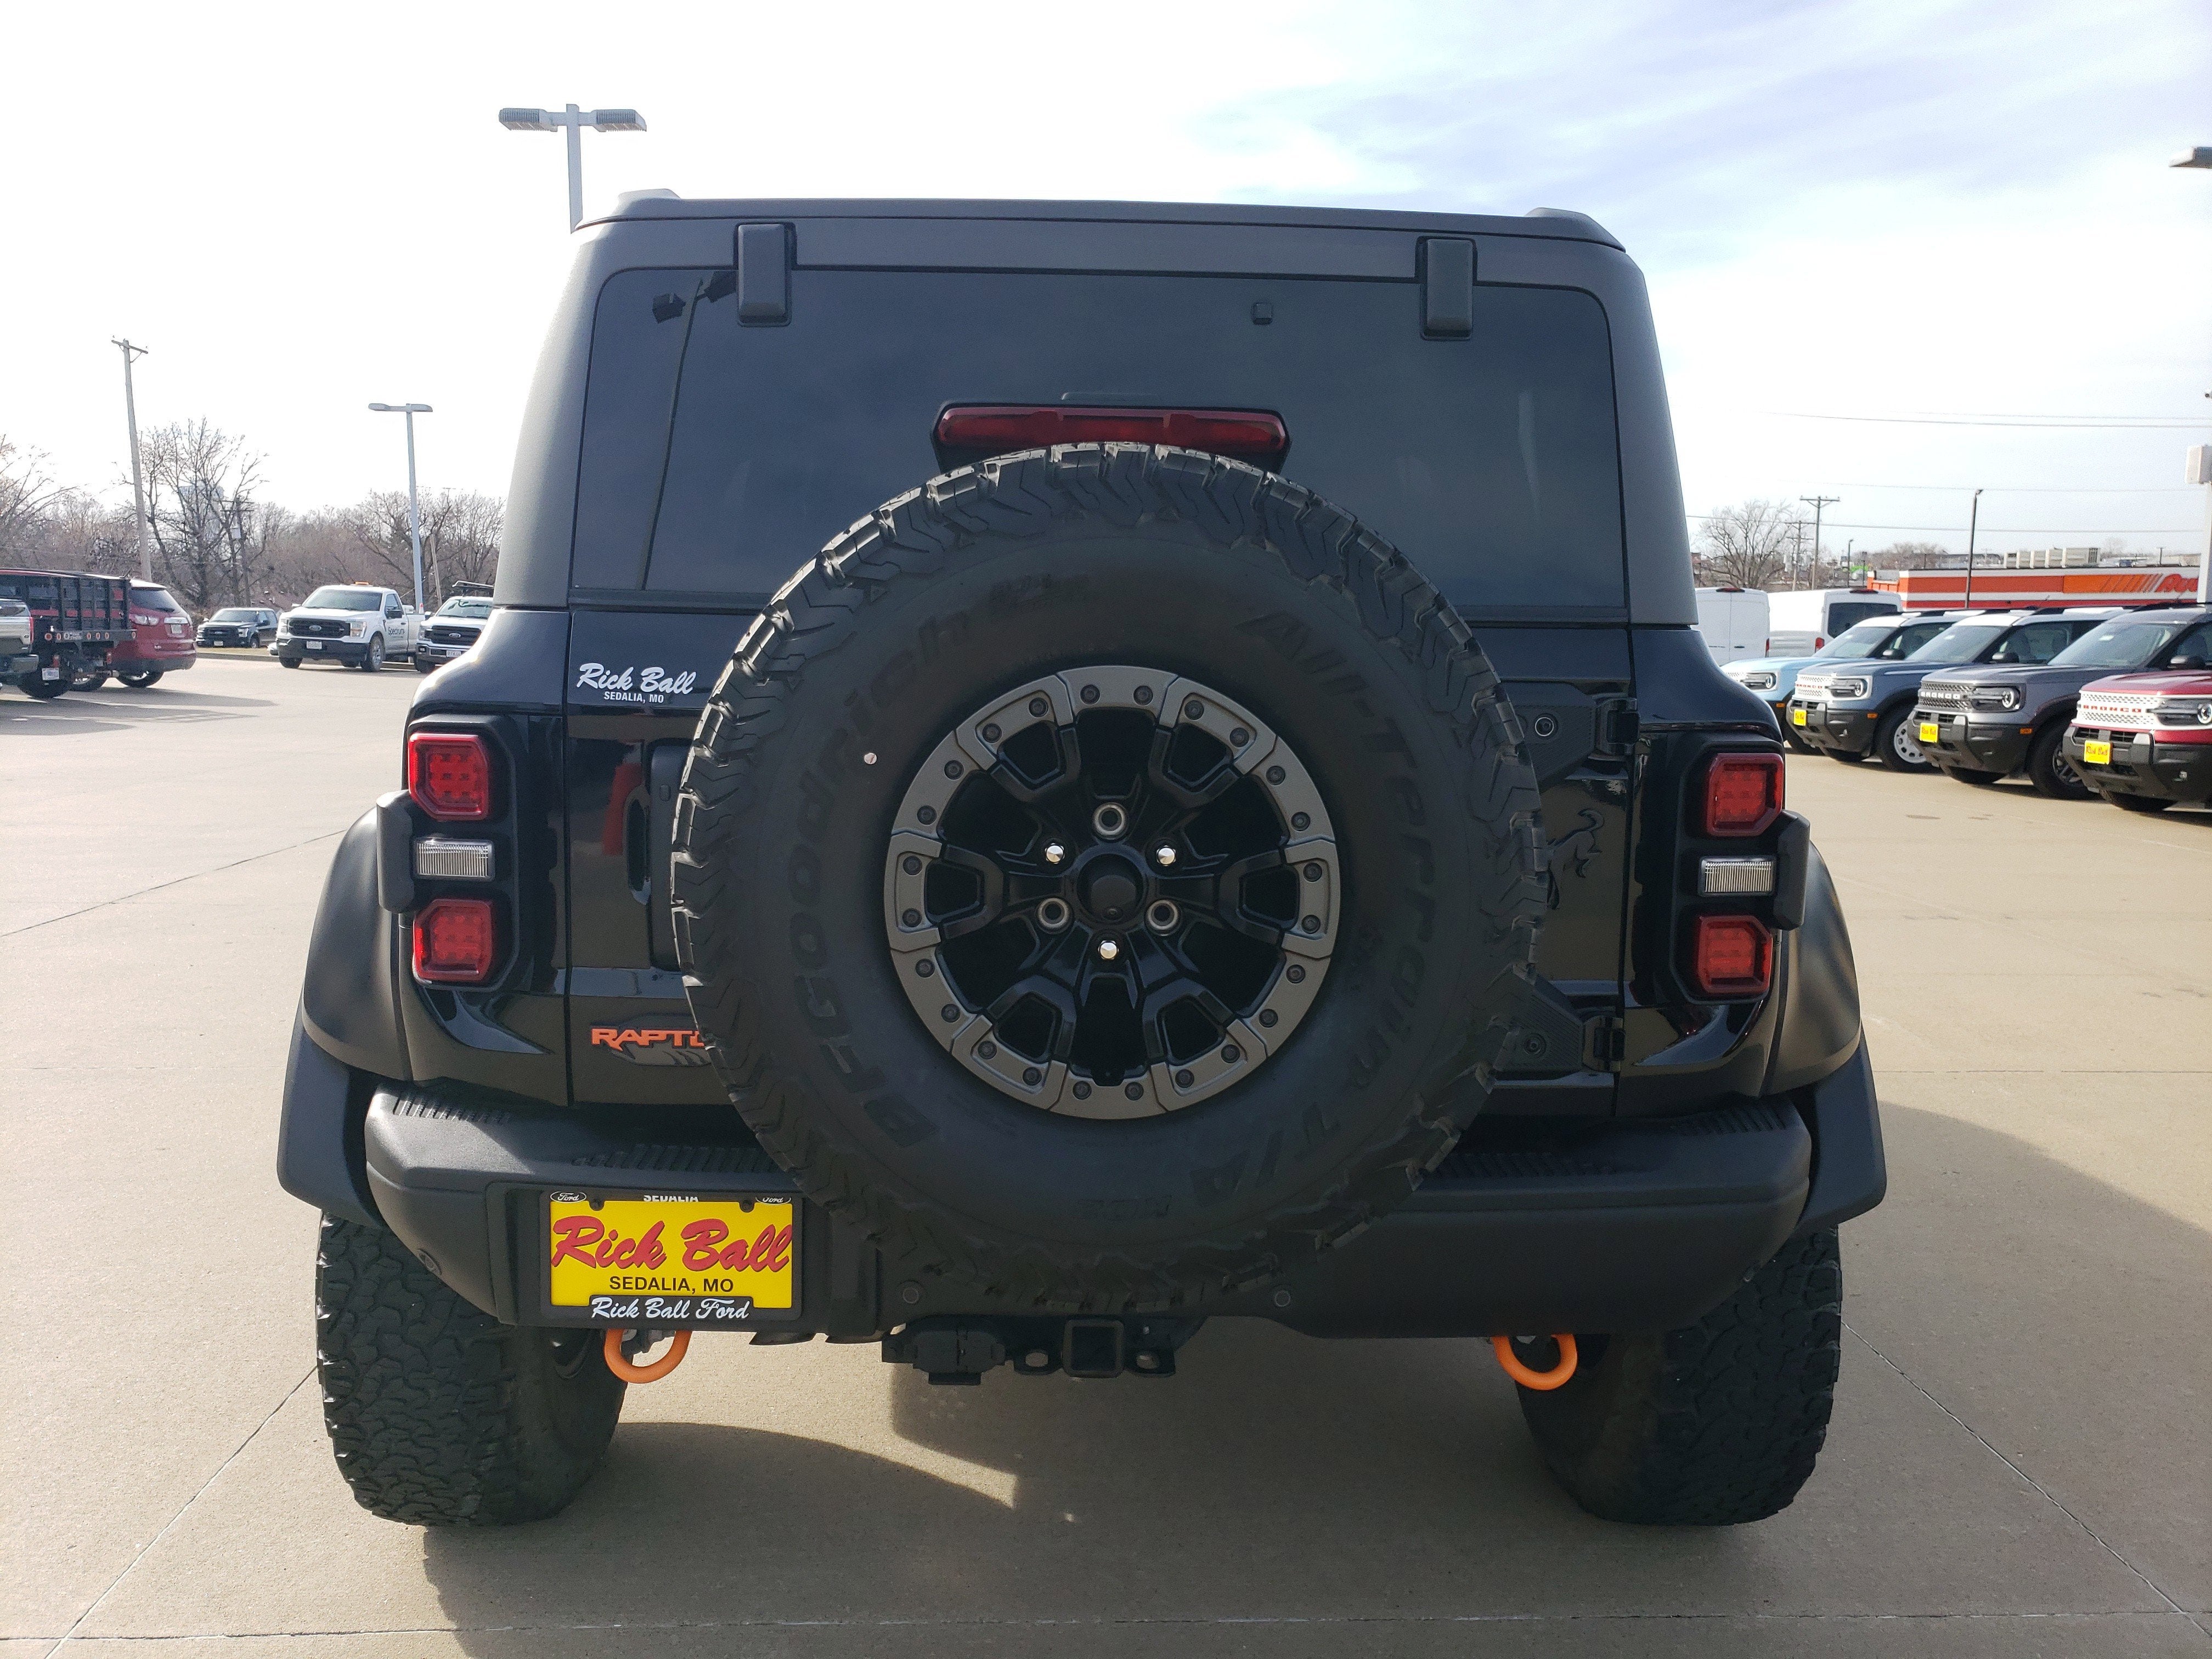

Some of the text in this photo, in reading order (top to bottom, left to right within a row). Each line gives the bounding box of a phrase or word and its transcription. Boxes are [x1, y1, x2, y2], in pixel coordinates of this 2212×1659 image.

[577, 663, 697, 695] Rick Ball
[603, 691, 664, 704] SEDALIA, MO
[1921, 691, 1961, 699] BRONCO
[2083, 704, 2142, 713] BRONCO
[788, 609, 971, 1149] BFGoodrich
[557, 1192, 580, 1201] Ford
[551, 1216, 792, 1272] Rick Ball
[609, 1276, 735, 1294] SEDALIA, MO
[591, 1297, 750, 1319] Rick Ball Ford
